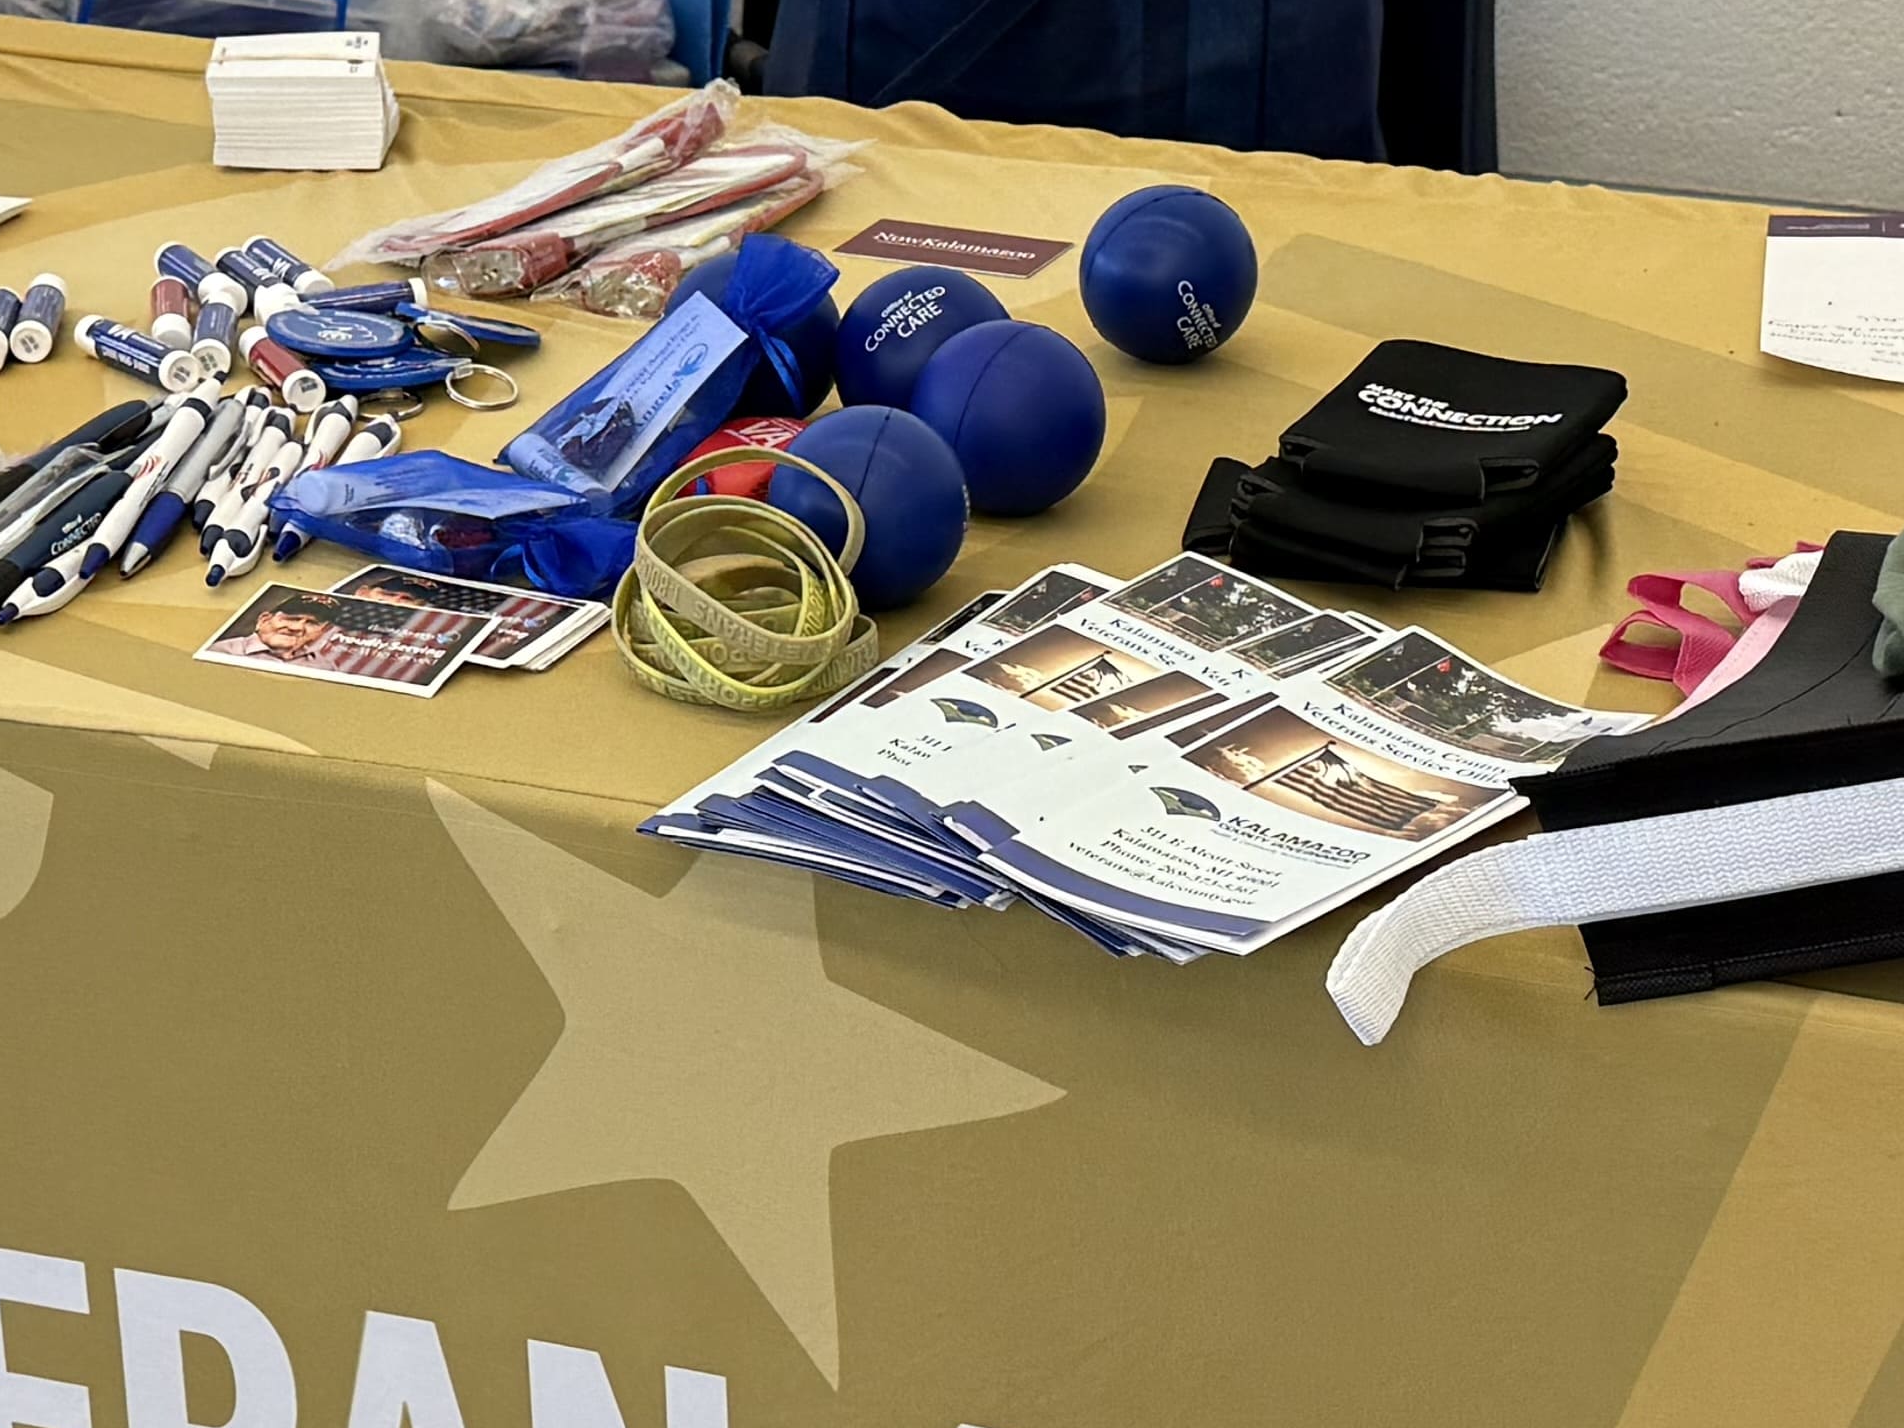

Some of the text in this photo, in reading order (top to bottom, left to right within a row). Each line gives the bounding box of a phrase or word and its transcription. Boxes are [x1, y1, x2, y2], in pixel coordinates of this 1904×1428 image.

[873, 231, 1036, 260] NowKalamazoo
[864, 285, 946, 353] CONNECTED
[897, 300, 944, 339] CARE
[1177, 315, 1203, 350] CARE
[1357, 390, 1564, 427] CONNECTION
[1302, 700, 1377, 748] Veterans
[1380, 741, 1452, 773] Service
[1333, 702, 1437, 756] Kalamazoo
[1227, 815, 1372, 862] KALAMAZOO
